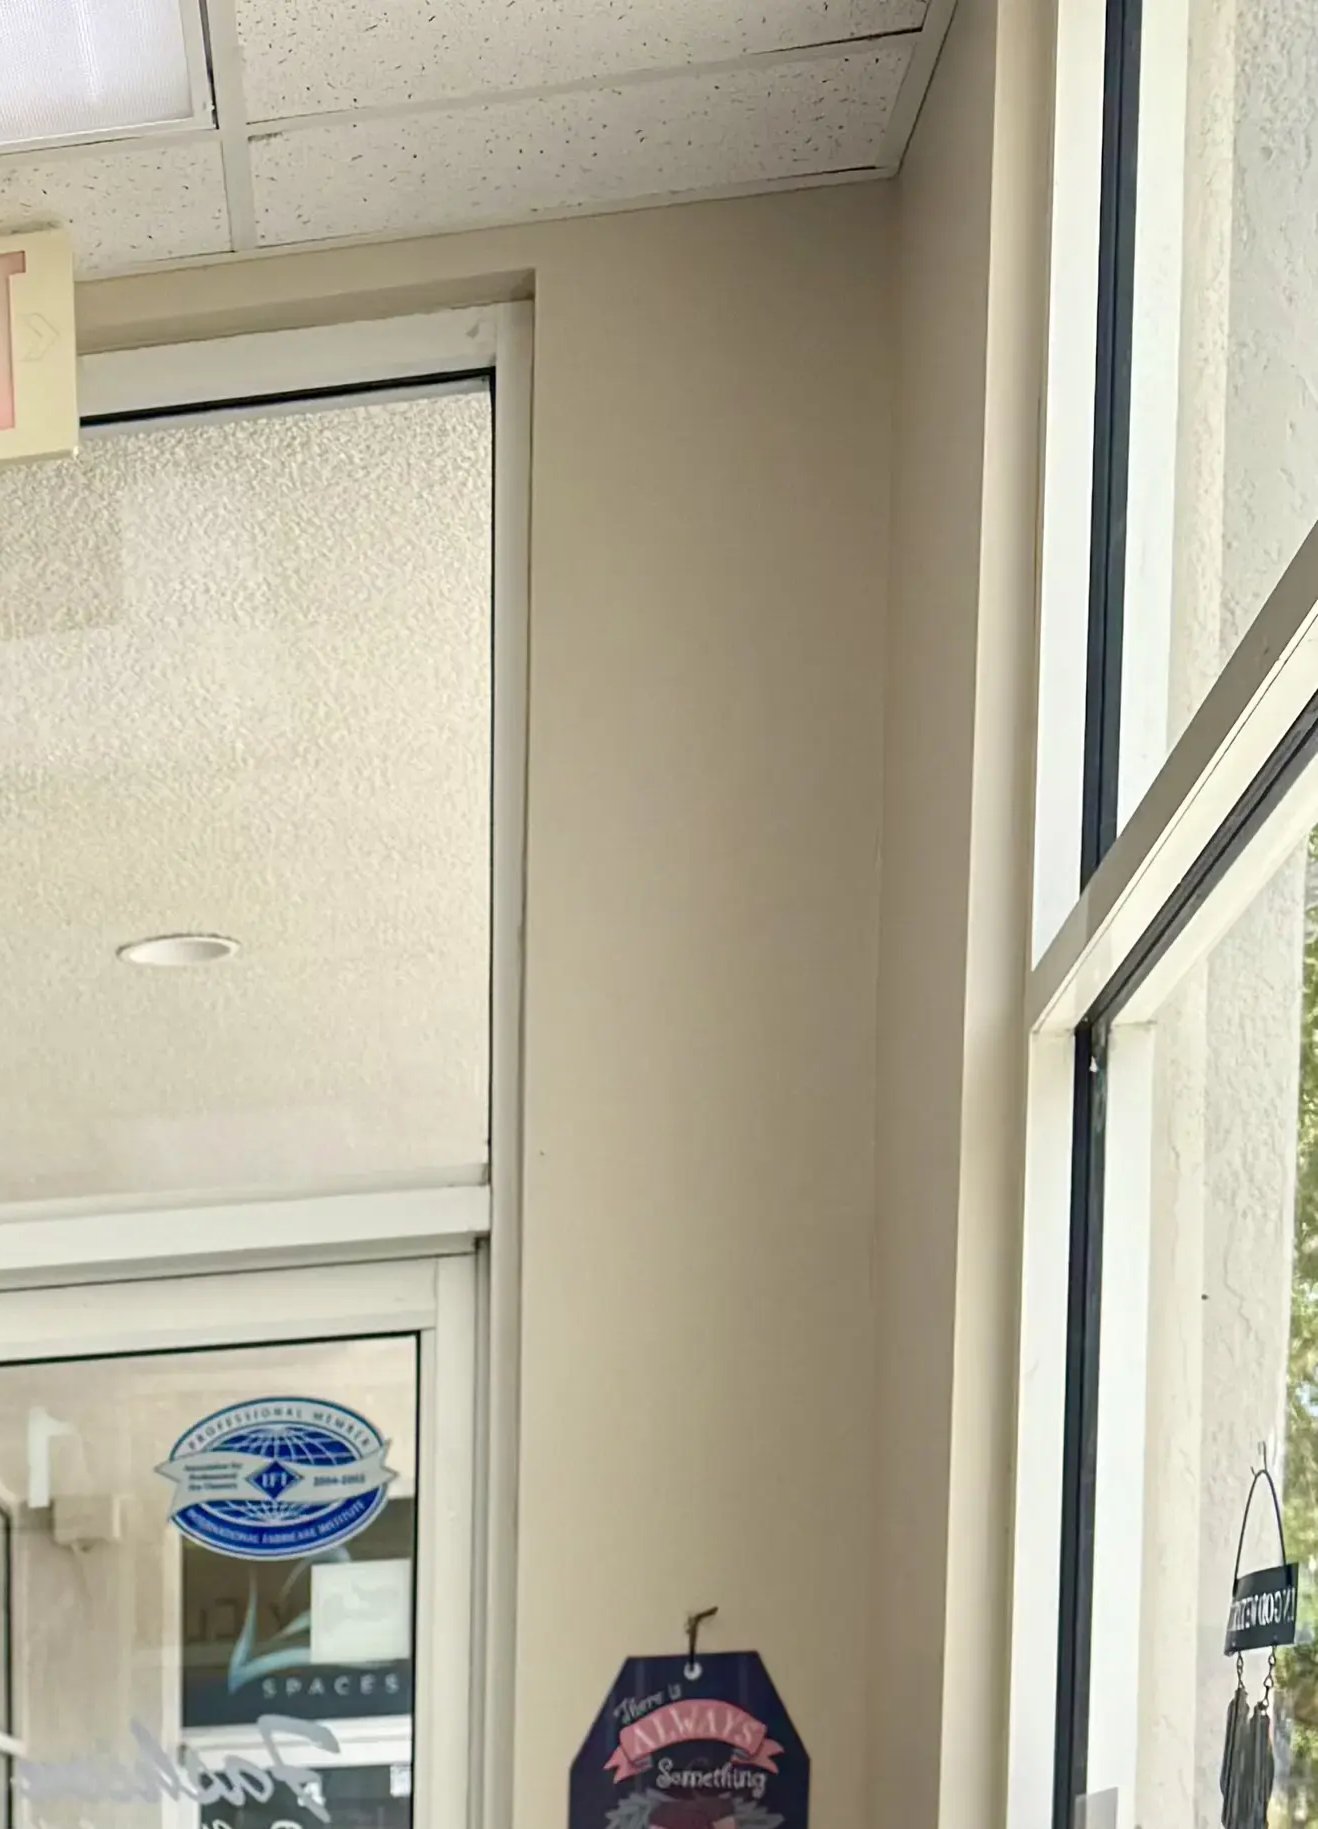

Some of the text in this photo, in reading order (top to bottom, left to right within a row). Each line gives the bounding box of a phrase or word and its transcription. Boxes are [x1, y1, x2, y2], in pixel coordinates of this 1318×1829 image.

[187, 1406, 370, 1450] PROFESSIONAL MEMBER
[317, 1500, 365, 1533] INSTITUTE
[262, 1672, 400, 1698] SPACES
[632, 1701, 756, 1753] ALWAYS
[655, 1757, 767, 1799] Something
